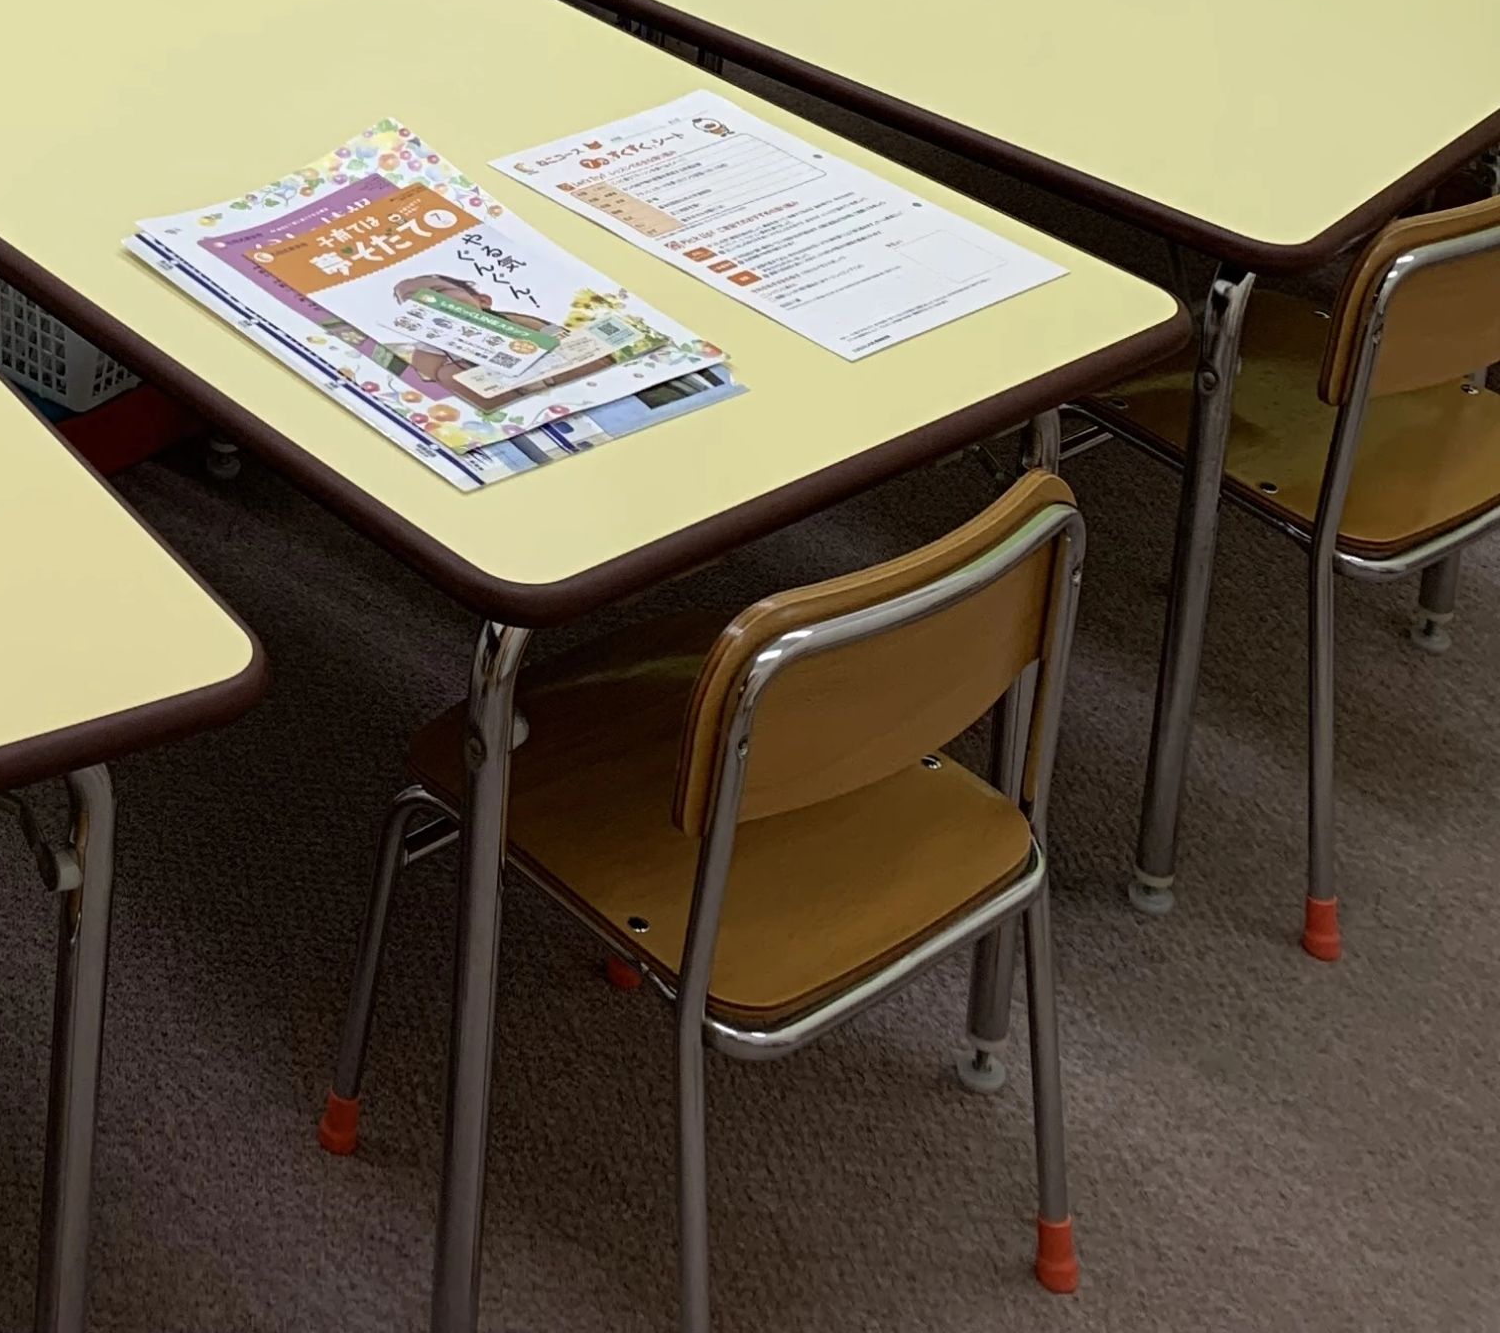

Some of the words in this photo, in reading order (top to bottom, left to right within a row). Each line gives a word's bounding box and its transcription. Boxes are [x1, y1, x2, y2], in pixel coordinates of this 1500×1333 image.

[536, 148, 585, 167] ねこコース
[309, 218, 433, 277] 夢そだて
[316, 216, 381, 249] 子育ては
[461, 234, 527, 273] やる気
[456, 249, 541, 309] ぐんぐん!
